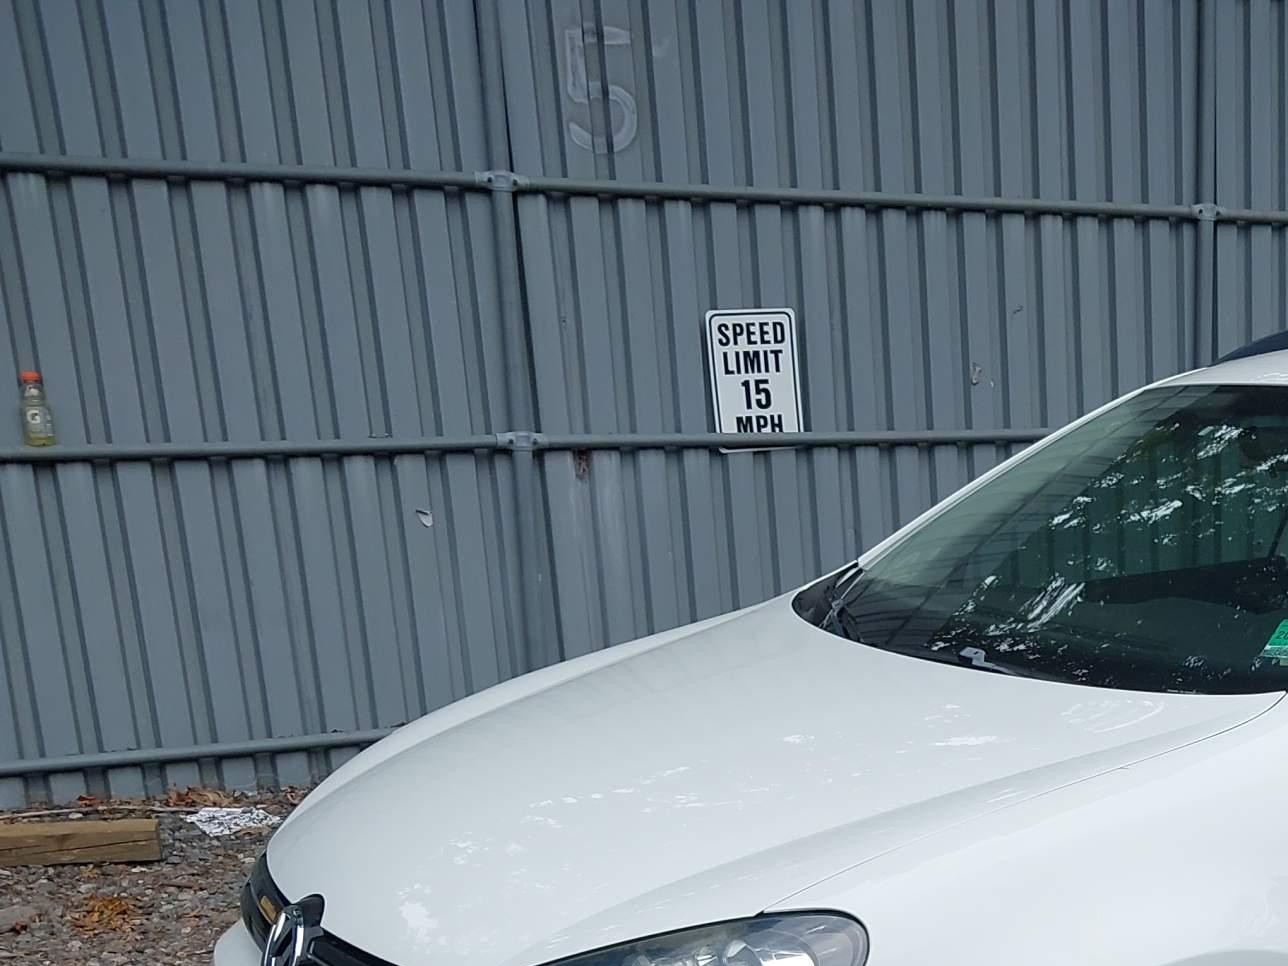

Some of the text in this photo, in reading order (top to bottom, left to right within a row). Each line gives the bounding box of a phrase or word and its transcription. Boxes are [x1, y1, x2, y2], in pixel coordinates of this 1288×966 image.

[564, 24, 638, 154] 5
[717, 321, 786, 346] SPEED
[722, 349, 783, 375] LIMIT
[740, 378, 772, 410] 15
[735, 414, 784, 433] MPH
